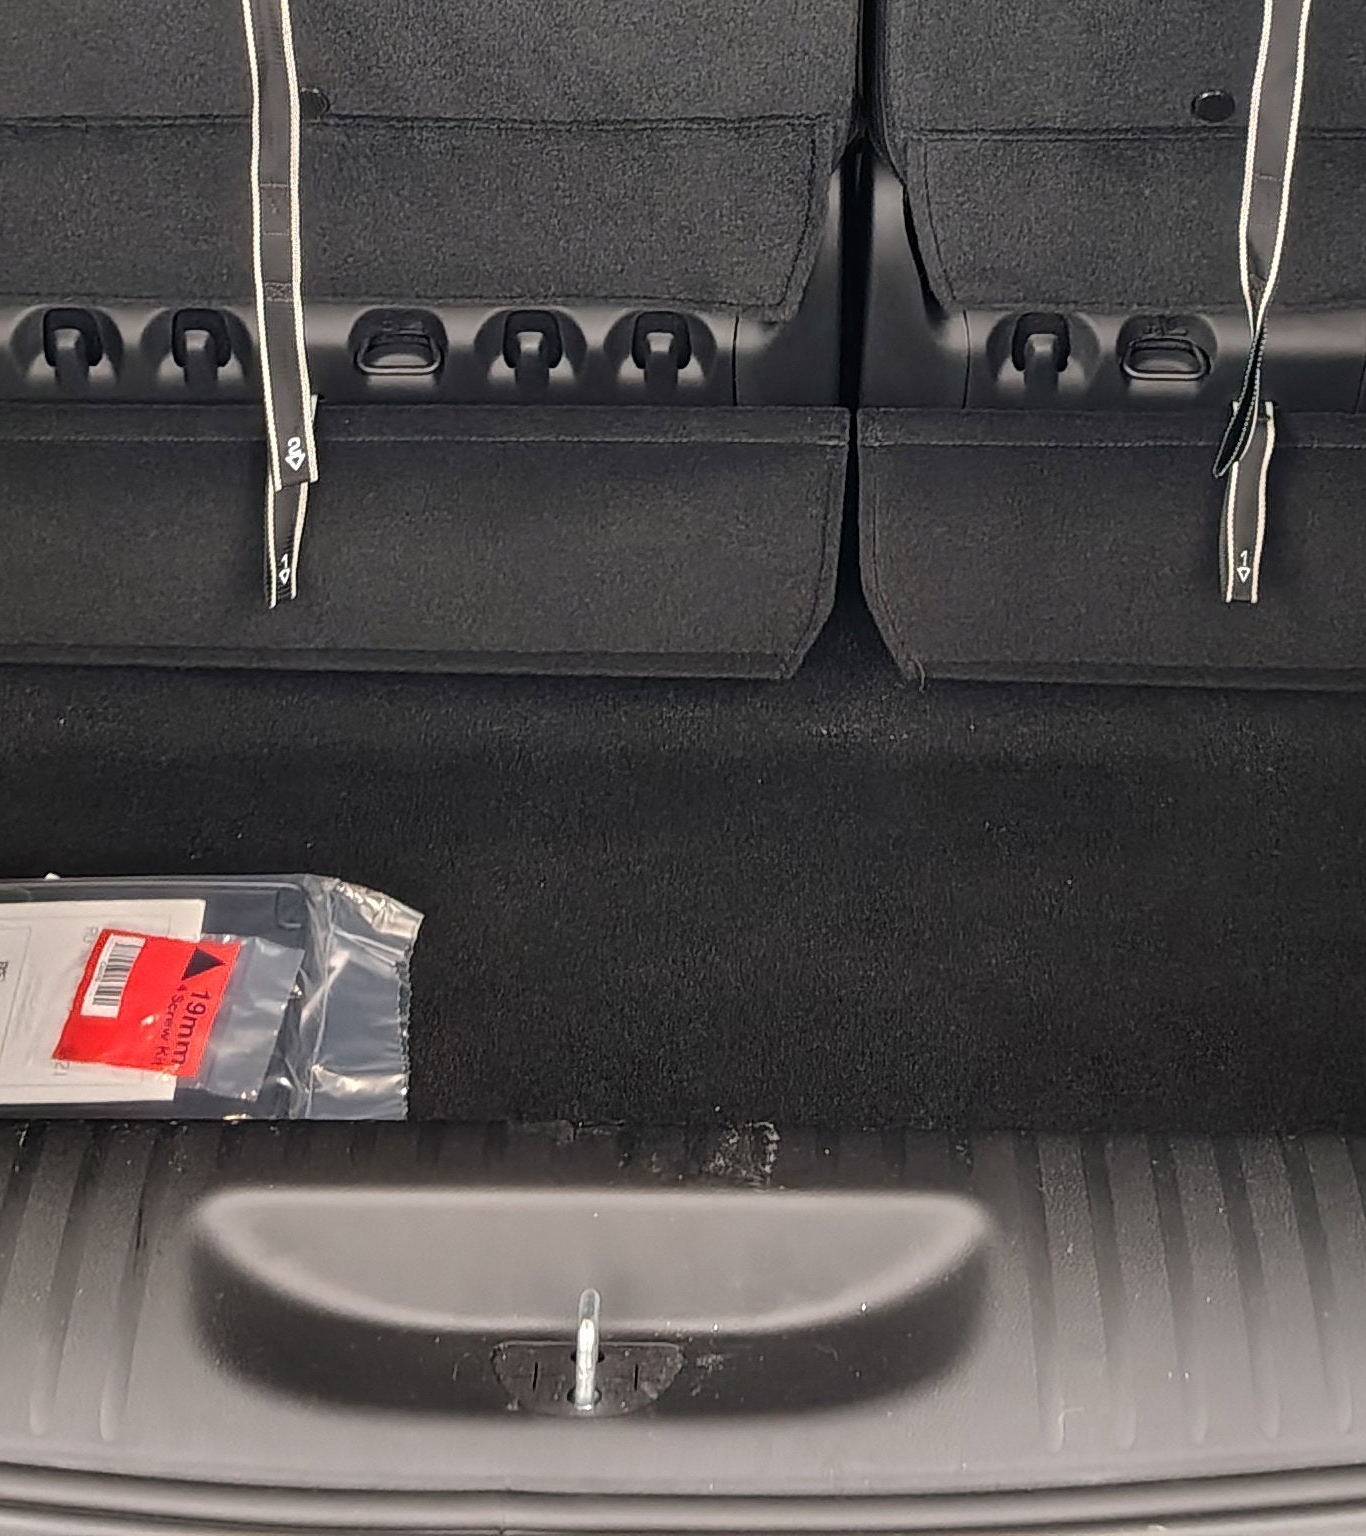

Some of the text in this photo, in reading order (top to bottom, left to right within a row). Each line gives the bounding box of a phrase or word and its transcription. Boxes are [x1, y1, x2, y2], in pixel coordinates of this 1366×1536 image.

[280, 553, 289, 569] 1
[1240, 549, 1248, 567] 1
[160, 994, 185, 1041] Screw
[171, 990, 211, 1065] 19mm
[150, 1046, 172, 1066] Kit
